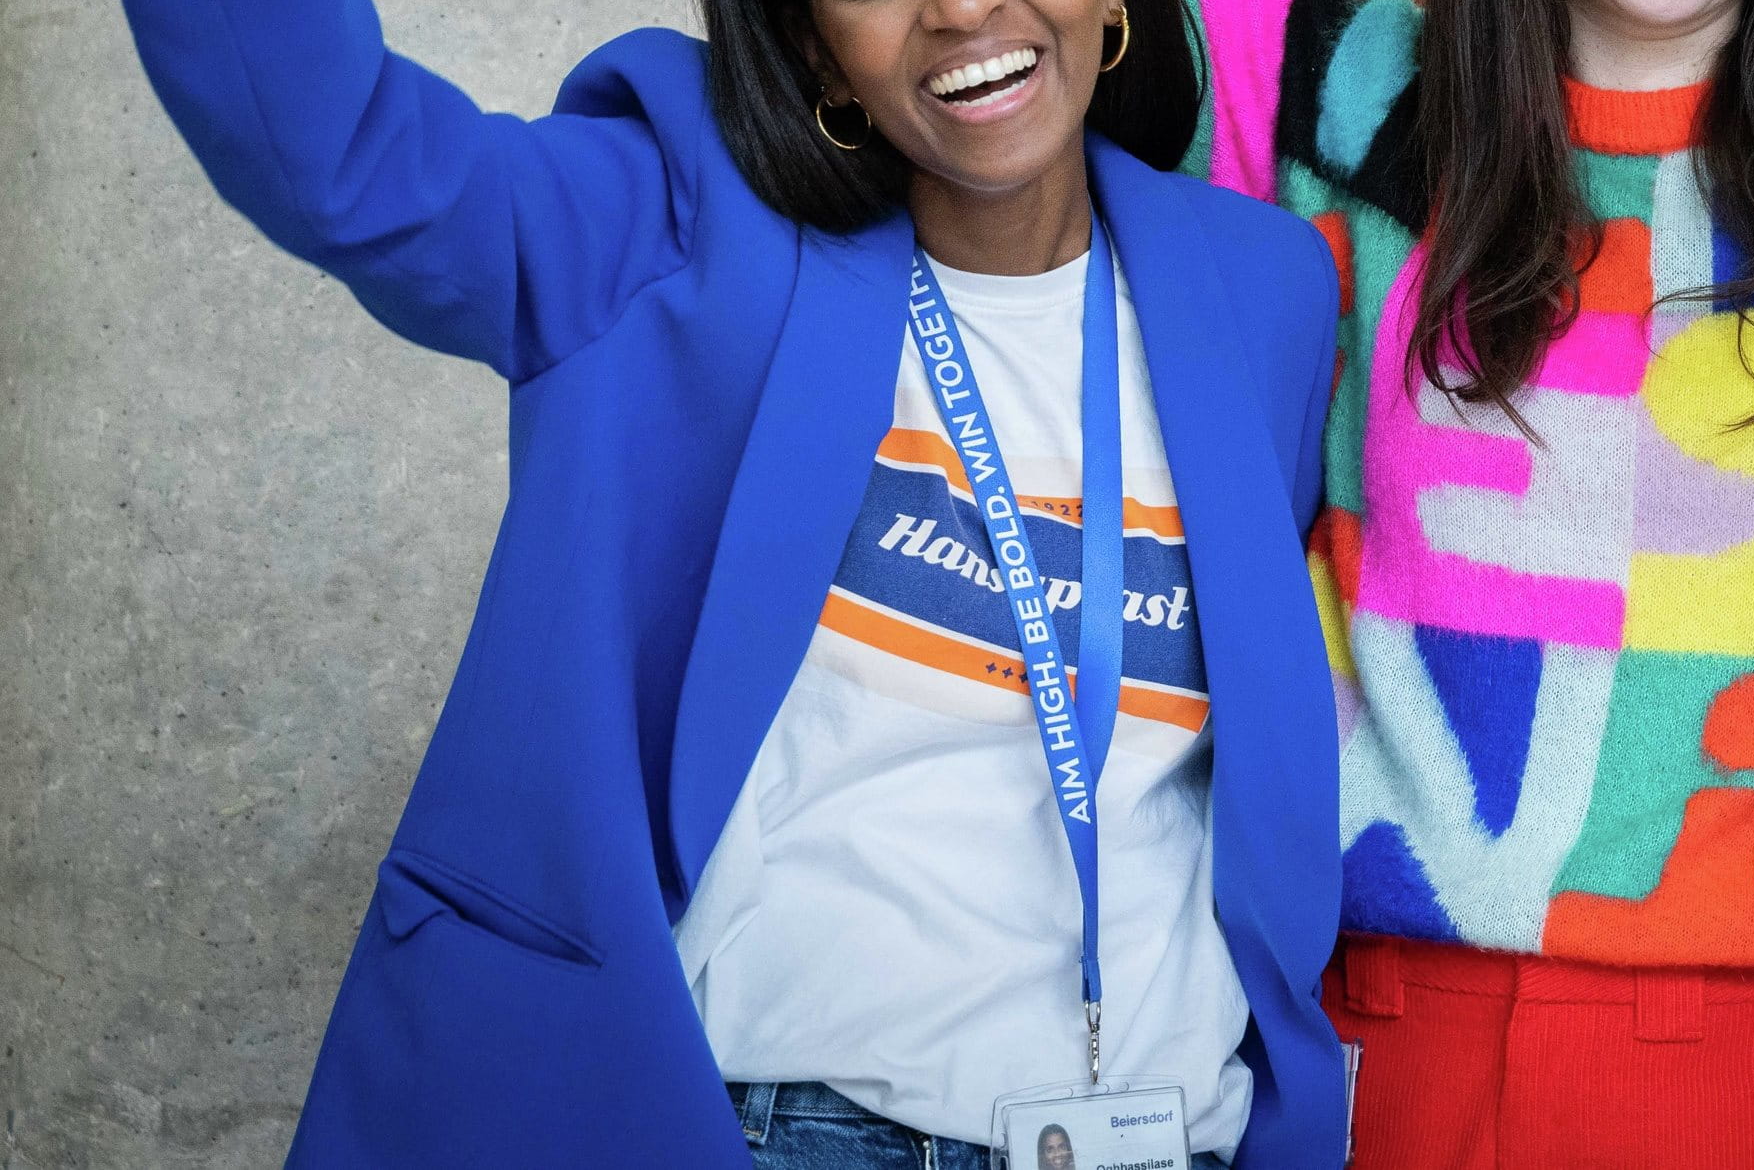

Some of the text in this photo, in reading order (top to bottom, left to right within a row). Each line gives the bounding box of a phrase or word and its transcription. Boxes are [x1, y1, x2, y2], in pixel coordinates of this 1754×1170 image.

[909, 256, 1091, 824] AIM HIGH. BE BOLD. WIN TOGETH
[1110, 1109, 1174, 1128] Beiersdorf
